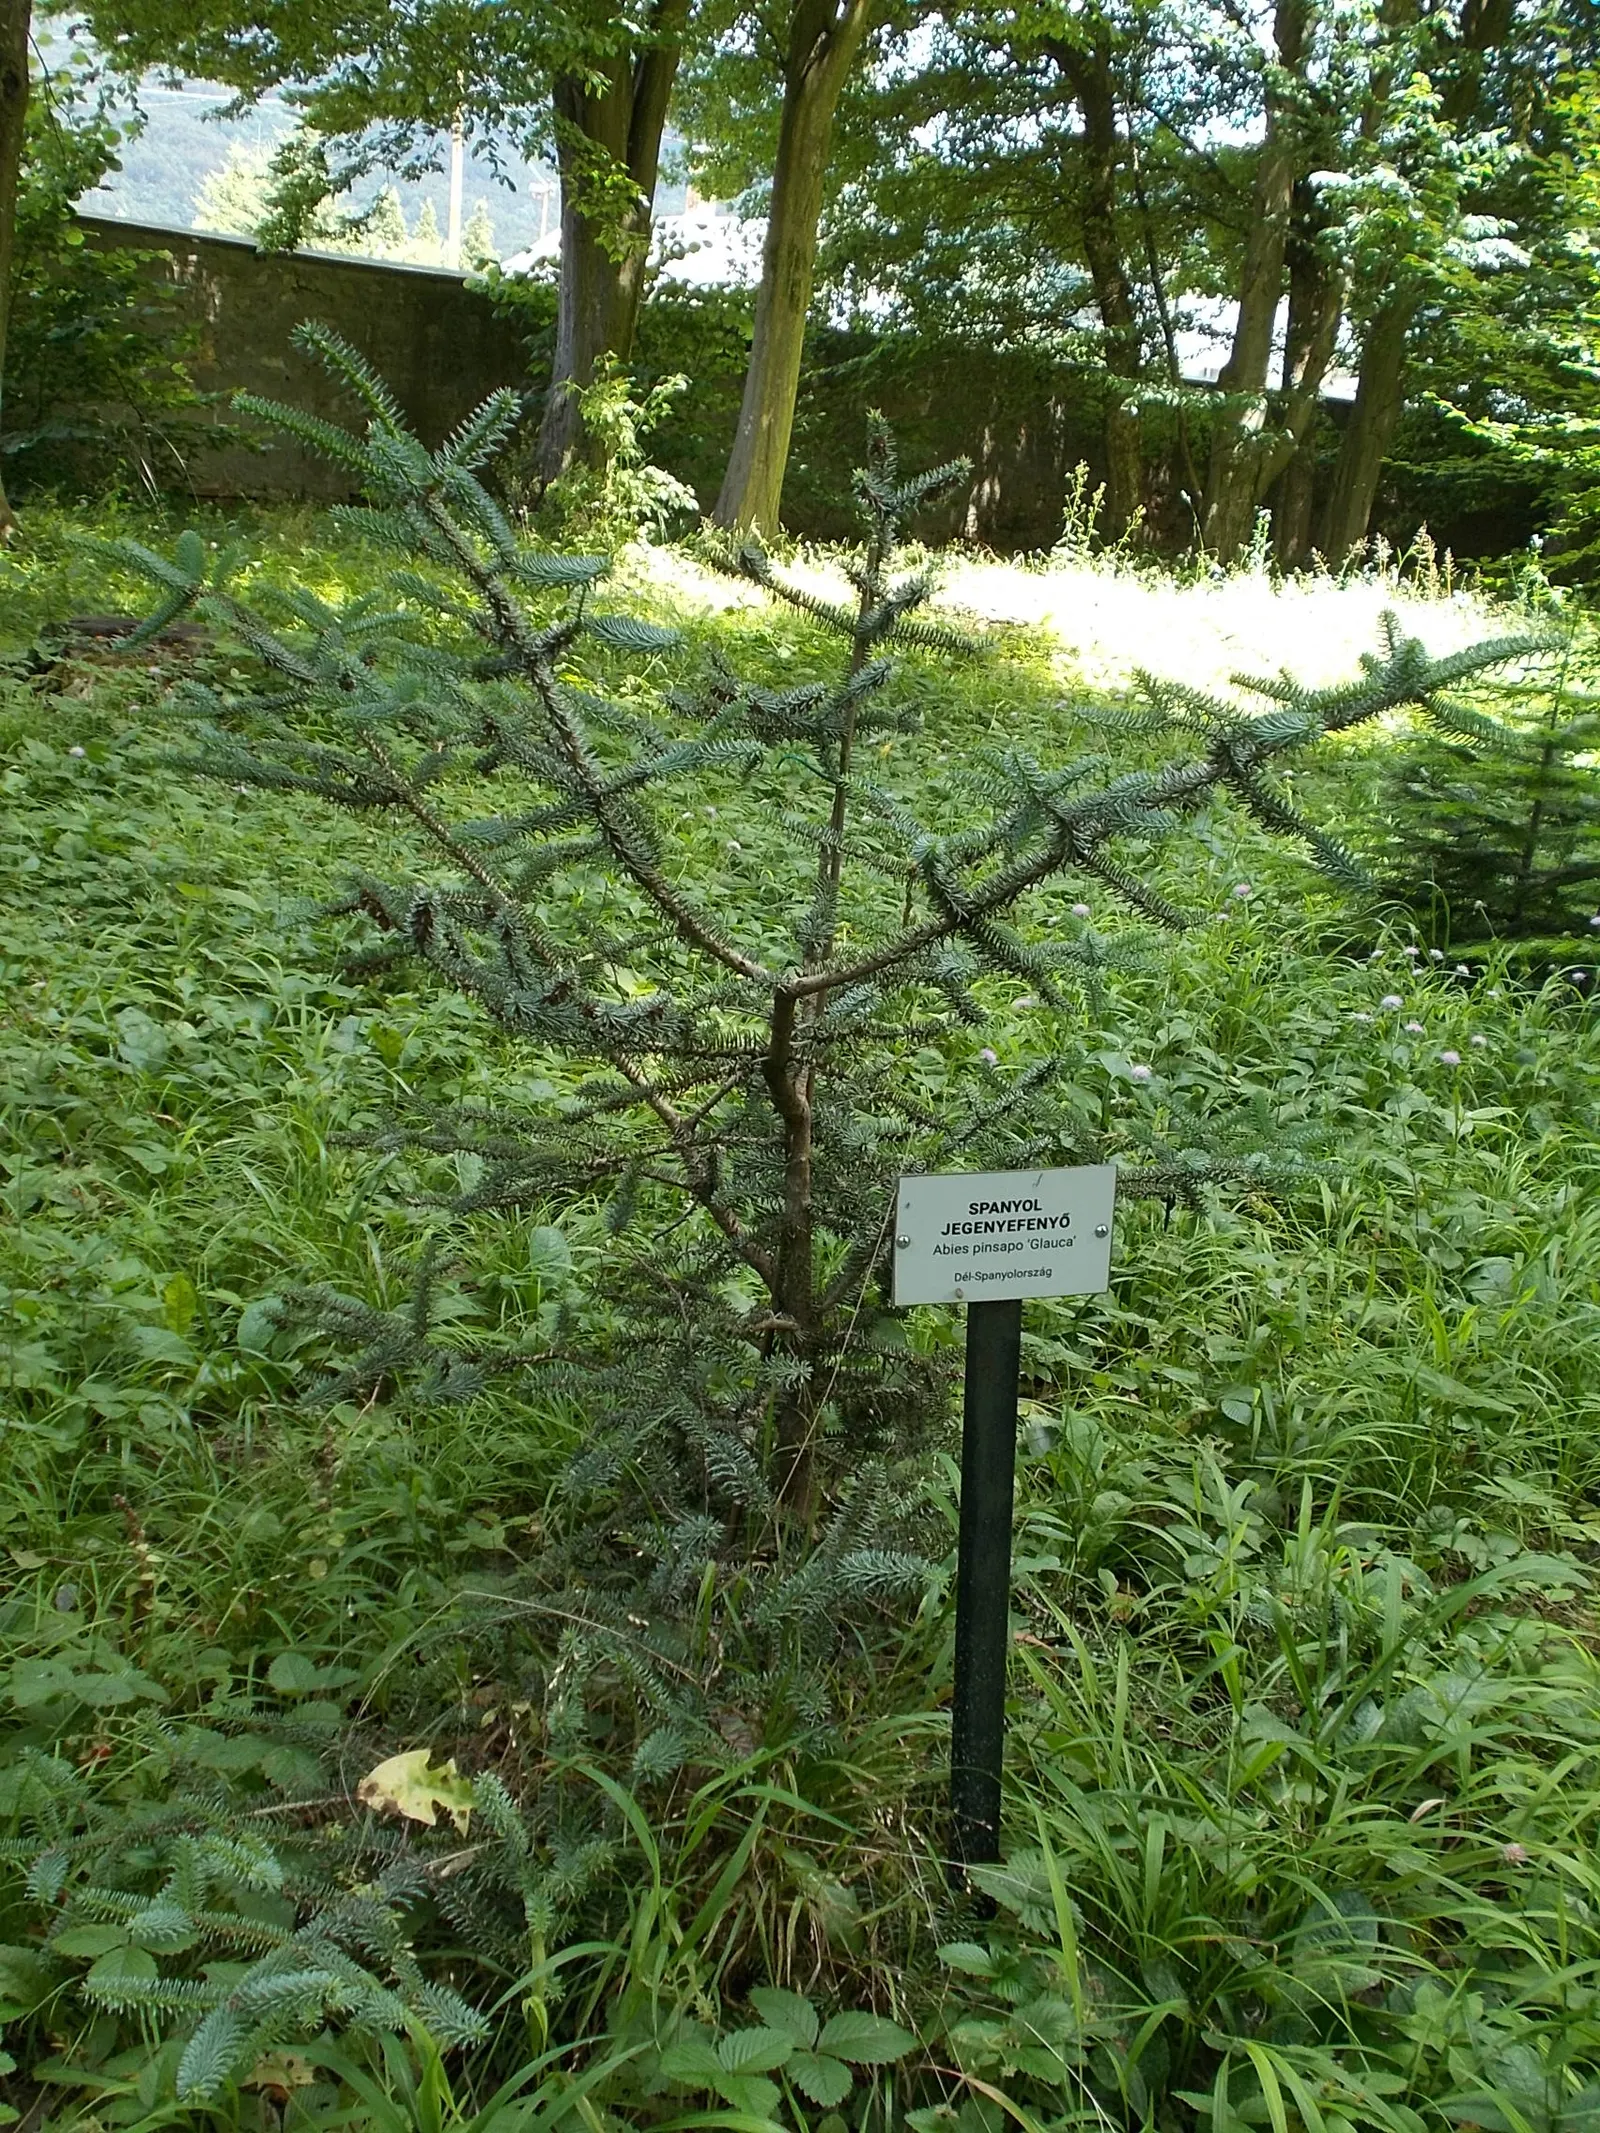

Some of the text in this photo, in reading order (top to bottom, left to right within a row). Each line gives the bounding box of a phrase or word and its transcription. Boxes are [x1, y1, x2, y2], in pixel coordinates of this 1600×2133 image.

[968, 1199, 1042, 1215] SPANYOL
[941, 1212, 1071, 1236] JEGENYEFENYŐ
[933, 1243, 969, 1255] Abies
[972, 1240, 1024, 1256] pinsapo
[954, 1266, 1053, 1283] Dél-Spanyolország
